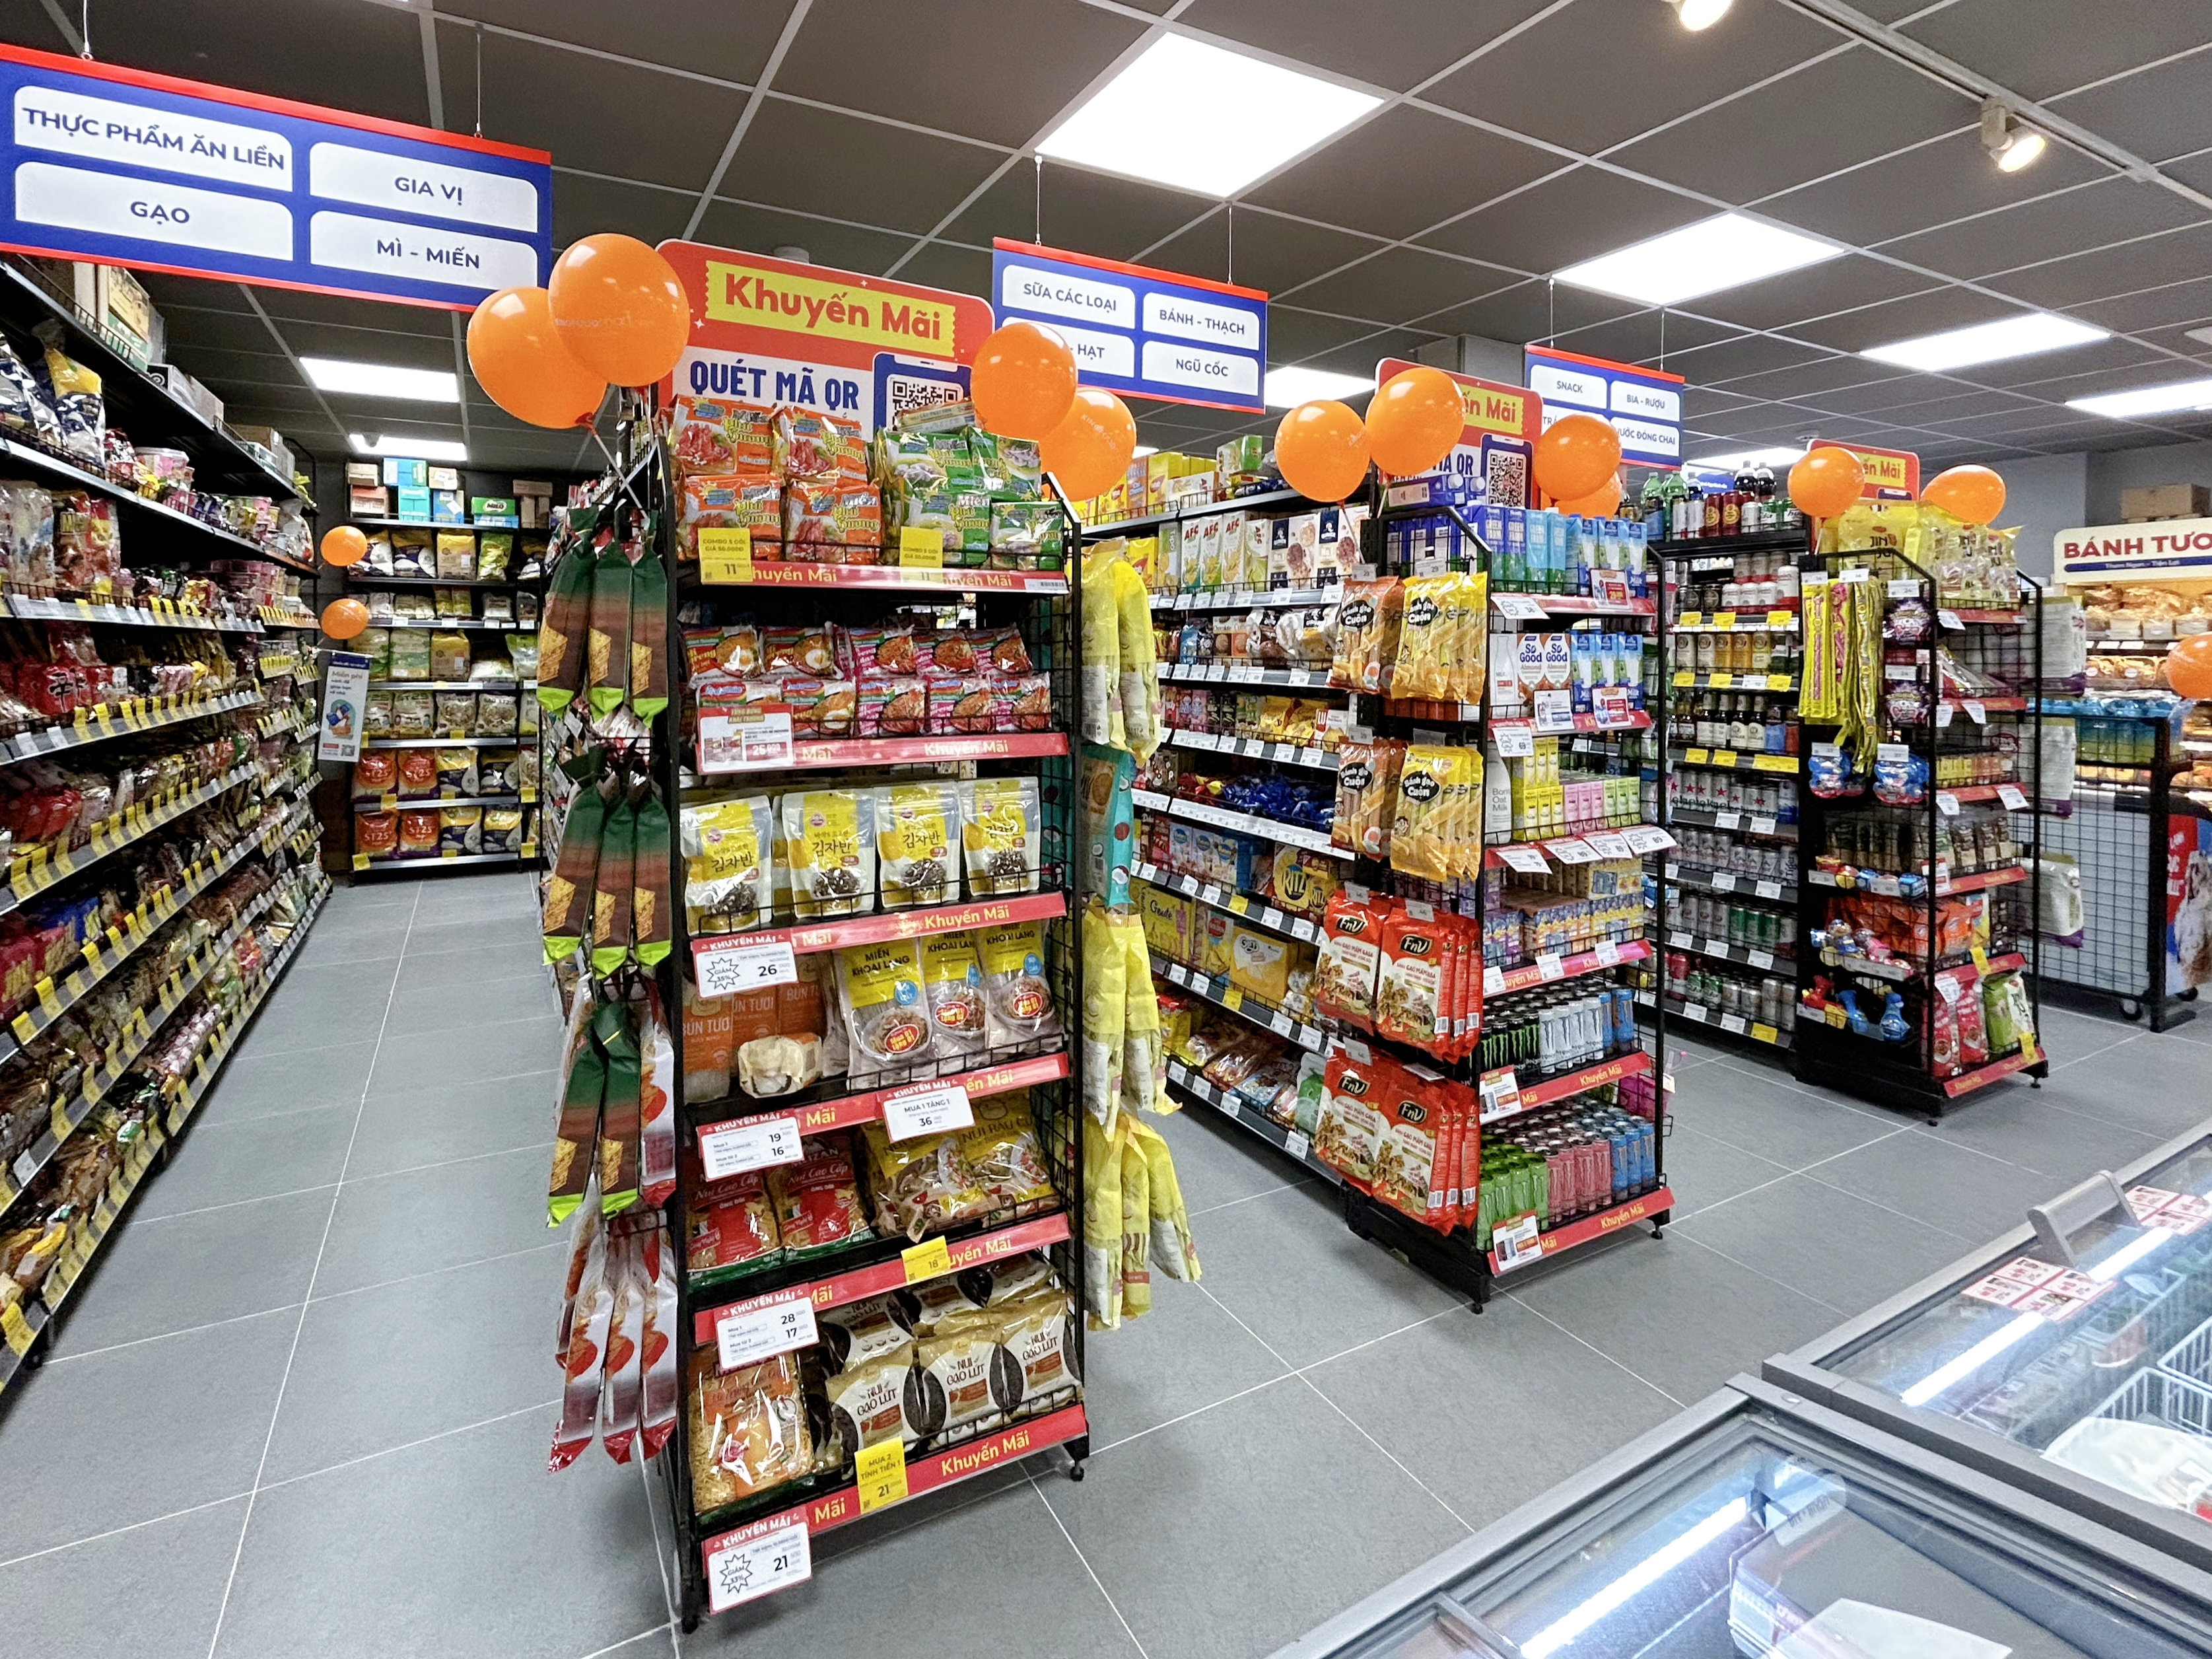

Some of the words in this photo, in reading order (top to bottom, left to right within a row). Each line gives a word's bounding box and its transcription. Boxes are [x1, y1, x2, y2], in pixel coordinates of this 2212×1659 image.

[22, 106, 99, 137] THỰC
[106, 124, 183, 154] PHẨM
[190, 137, 226, 161] ĂN
[233, 145, 285, 170] LIỀN
[394, 176, 434, 198] GIA
[440, 184, 464, 205] VỊ
[130, 201, 190, 225] GẠO
[377, 236, 403, 258] MÌ
[427, 245, 480, 270] MIẾN
[1023, 282, 1052, 300] SỮA
[1056, 288, 1082, 304] CÁC
[1087, 296, 1117, 313] LOẠI
[725, 273, 870, 329] Khuyến
[881, 302, 940, 340] Mãi
[1159, 308, 1194, 325] BÁNH
[1205, 318, 1245, 335] THẠCH
[1078, 344, 1105, 361] HẠT
[1176, 358, 1201, 372] NGŨ
[1204, 361, 1229, 376] CỐC
[690, 359, 767, 399] QUÉT
[775, 367, 816, 405] MÃ
[825, 378, 860, 411] QR
[1556, 380, 1583, 393] SNACK
[1486, 396, 1516, 423] Mãi
[1626, 394, 1639, 404] BIA
[1645, 398, 1665, 410] RƯỢU
[1618, 428, 1635, 439] ƯỚC
[1636, 429, 1657, 442] ĐÓNG
[1659, 435, 1676, 444] CHAI
[1879, 460, 1900, 479] Mãi
[1184, 524, 1199, 540] AFC
[1203, 522, 1218, 539] AFC
[1226, 518, 1239, 533] AFC
[2064, 536, 2143, 558] BÁNH
[724, 563, 736, 575] 11
[752, 566, 803, 582] huyến
[808, 568, 837, 582] Mãi
[987, 573, 1012, 586] Mãi
[1525, 643, 1537, 653] So
[1552, 643, 1562, 653] So
[1520, 653, 1542, 662] Good
[1546, 653, 1568, 662] Good
[1317, 713, 1327, 725] LU
[983, 739, 1009, 754] Mãi
[812, 839, 852, 857] 김자반
[903, 832, 941, 849] 김자반
[712, 851, 754, 872] 김자반
[1282, 872, 1306, 896] RITZ
[802, 929, 832, 946] Mãi
[925, 909, 981, 929] Khuyến
[984, 905, 1010, 919] Mãi
[1340, 916, 1365, 932] FnV
[710, 935, 753, 950] KHUYẾN
[756, 935, 777, 944] MÃI
[986, 935, 1013, 945] KHOAI
[1016, 930, 1035, 940] LANG
[1404, 937, 1428, 953] FnV
[927, 942, 957, 952] KHOAI
[959, 940, 975, 949] LAN
[865, 947, 890, 962] MIẾN
[758, 964, 777, 977] 26
[852, 963, 881, 977] KHOAI
[1582, 958, 1599, 968] Khu
[1505, 973, 1527, 987] uyến
[733, 998, 746, 1012] ÚN
[707, 1018, 730, 1033] TƯƠ
[988, 1069, 1014, 1086] Mãi
[1579, 1068, 1608, 1086] Khuyến
[1609, 1064, 1623, 1077] Mãi
[893, 1082, 932, 1099] KHUYẾN
[933, 1080, 951, 1089] MÃI
[1342, 1077, 1365, 1094] FnV
[904, 1105, 922, 1113] MUA
[926, 1100, 946, 1110] TẶNG
[1521, 1092, 1538, 1106] Mãi
[806, 1108, 836, 1128] Mãi
[1401, 1103, 1424, 1122] FnV
[714, 1115, 757, 1132] KHUYẾN
[759, 1112, 780, 1121] MÃI
[918, 1116, 932, 1127] 36
[769, 1133, 781, 1143] 19
[771, 1147, 784, 1156] 16
[808, 1168, 827, 1178] Cao
[830, 1162, 848, 1175] Cấp
[1601, 1211, 1630, 1230] Khuyến
[1631, 1203, 1645, 1217] Mãi
[1540, 1235, 1557, 1251] Mãi
[950, 1244, 982, 1267] uyến
[985, 1236, 1012, 1255] Mãi
[928, 1259, 939, 1269] 18
[730, 1294, 773, 1316] KHUYẾN
[775, 1291, 796, 1304] MÃI
[781, 1314, 796, 1325] 28
[786, 1327, 797, 1339] 17
[957, 1356, 974, 1370] NUI
[866, 1384, 883, 1399] NUI
[942, 1442, 1000, 1476] Khuyến
[1002, 1430, 1029, 1454] Mãi
[868, 1455, 885, 1468] MUA
[860, 1466, 880, 1481] TÍNH
[879, 1460, 896, 1475] TIỀN
[878, 1484, 890, 1498] 21
[815, 1497, 846, 1524] Mãi
[722, 1518, 768, 1549] KHUYẾN
[770, 1515, 791, 1530] MÃI
[773, 1555, 788, 1572] 21
